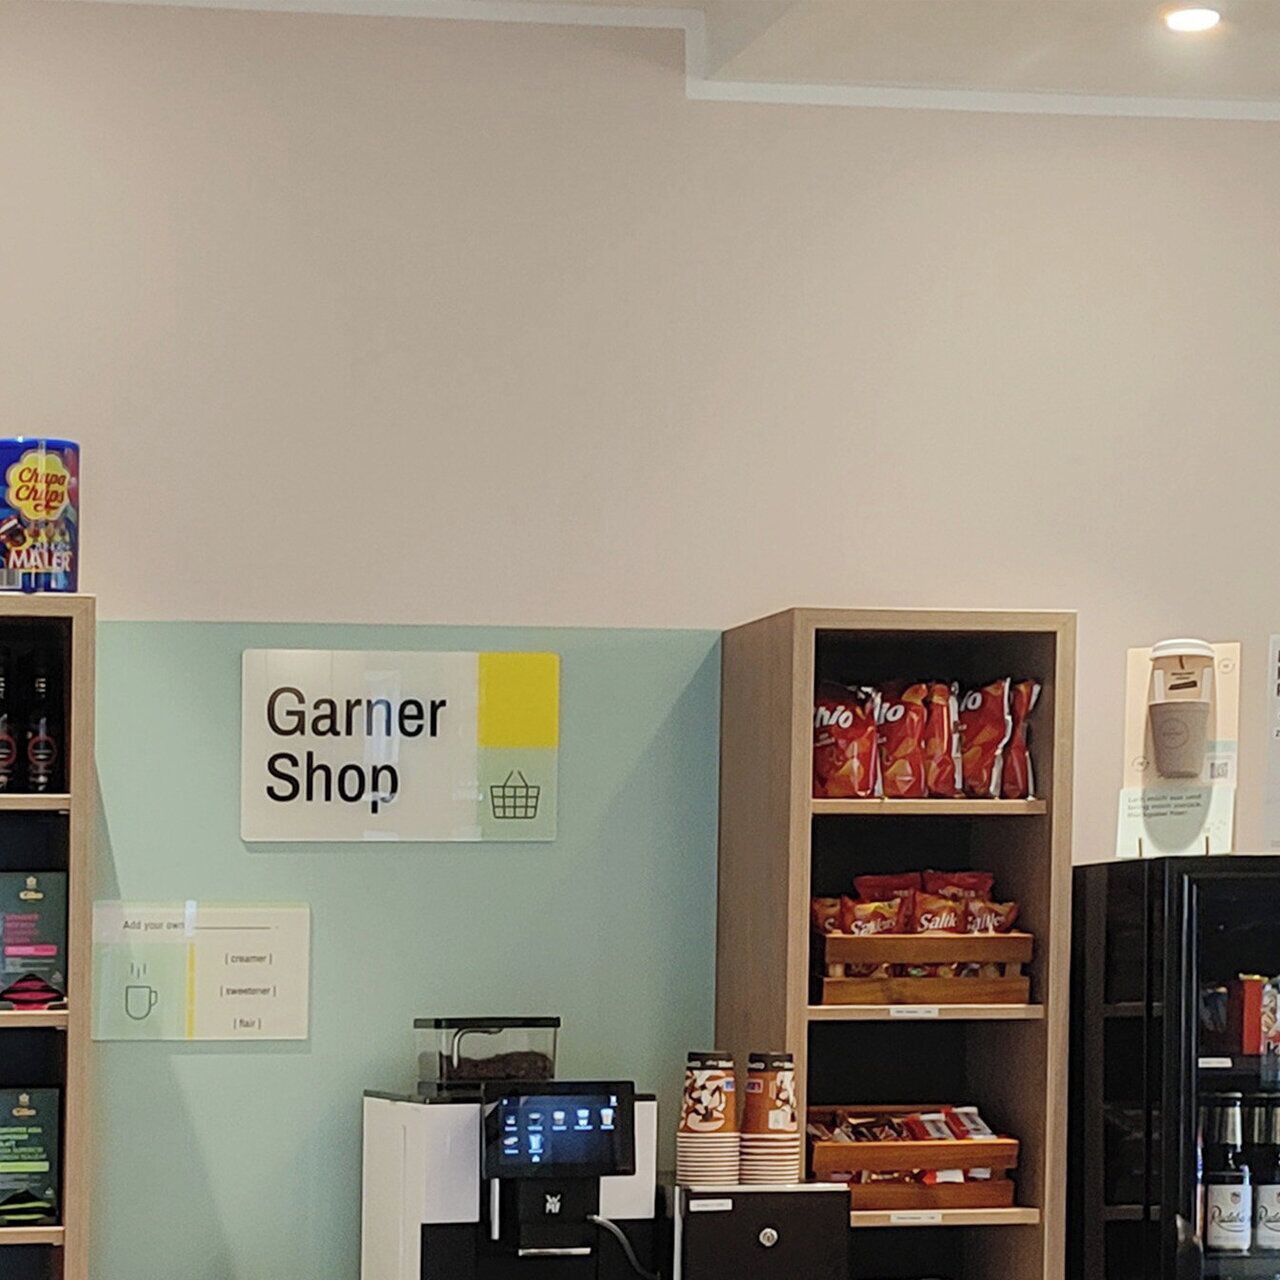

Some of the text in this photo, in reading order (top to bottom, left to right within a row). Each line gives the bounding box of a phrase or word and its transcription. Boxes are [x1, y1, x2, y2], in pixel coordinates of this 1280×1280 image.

[265, 686, 448, 739] Garner
[815, 704, 854, 729] hio
[265, 751, 400, 815] Shop
[122, 919, 185, 932] Add your own
